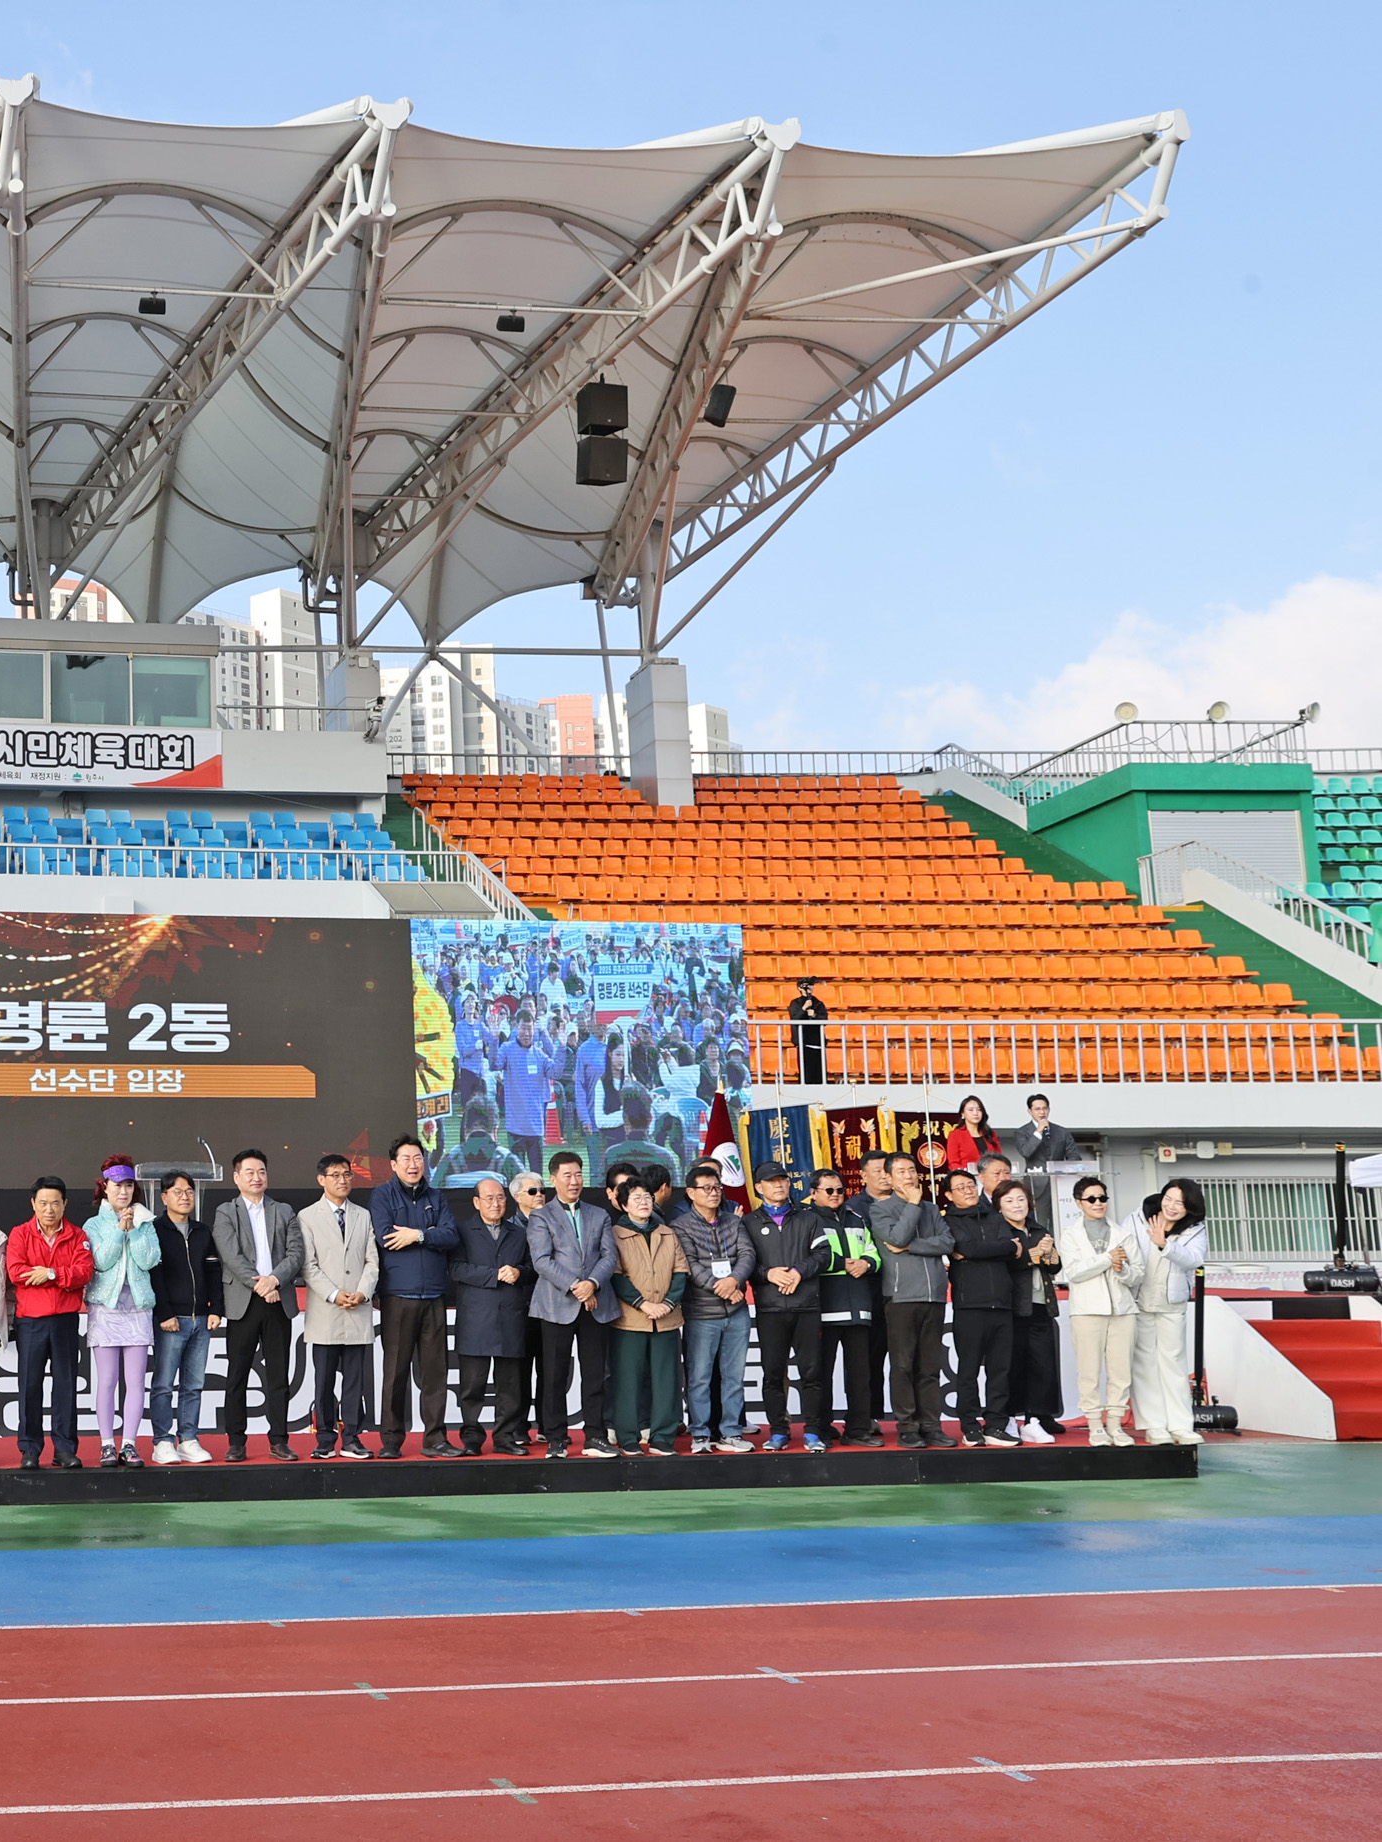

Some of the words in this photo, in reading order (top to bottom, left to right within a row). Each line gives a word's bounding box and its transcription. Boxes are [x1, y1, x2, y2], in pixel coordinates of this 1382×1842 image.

[388, 735, 403, 743] 202
[30, 772, 61, 781] 재정지원
[85, 773, 104, 782] 원주시
[598, 982, 626, 1000] 명륜2동
[628, 981, 649, 998] 선수단
[127, 1002, 231, 1053] 2동
[28, 1068, 118, 1093] 선수단
[127, 1068, 186, 1094] 입장
[1330, 1277, 1355, 1288] DASH
[1194, 1413, 1214, 1424] ASH
